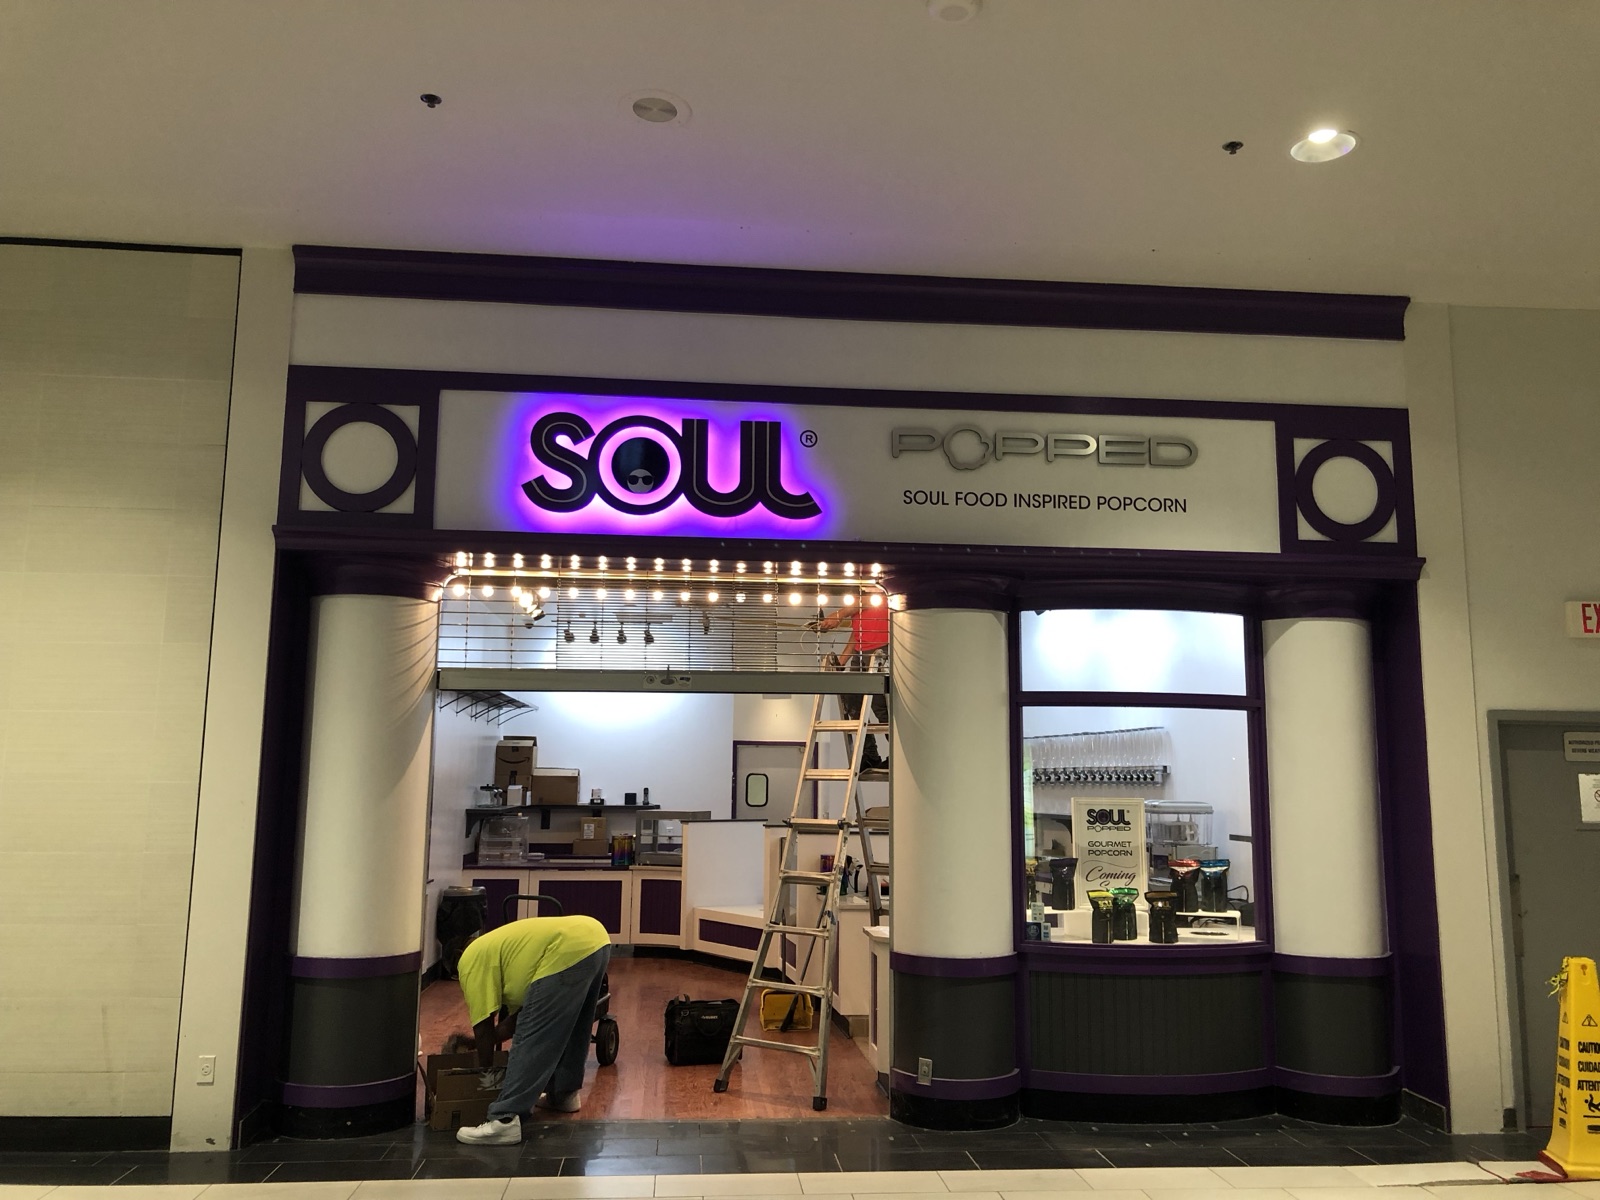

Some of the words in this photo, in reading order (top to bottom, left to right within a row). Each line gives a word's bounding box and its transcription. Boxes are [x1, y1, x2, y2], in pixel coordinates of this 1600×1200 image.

[891, 423, 1199, 471] POPPED
[521, 411, 823, 519] SOUL
[903, 490, 949, 506] SOUL
[955, 491, 1008, 508] FOOD
[1014, 493, 1091, 510] INSPIRED
[1097, 495, 1187, 513] POPCORN
[1086, 808, 1131, 826] SOUL
[1087, 840, 1132, 848] GOURMET
[1088, 849, 1132, 857] POPCORN
[1085, 865, 1137, 887] Coming
